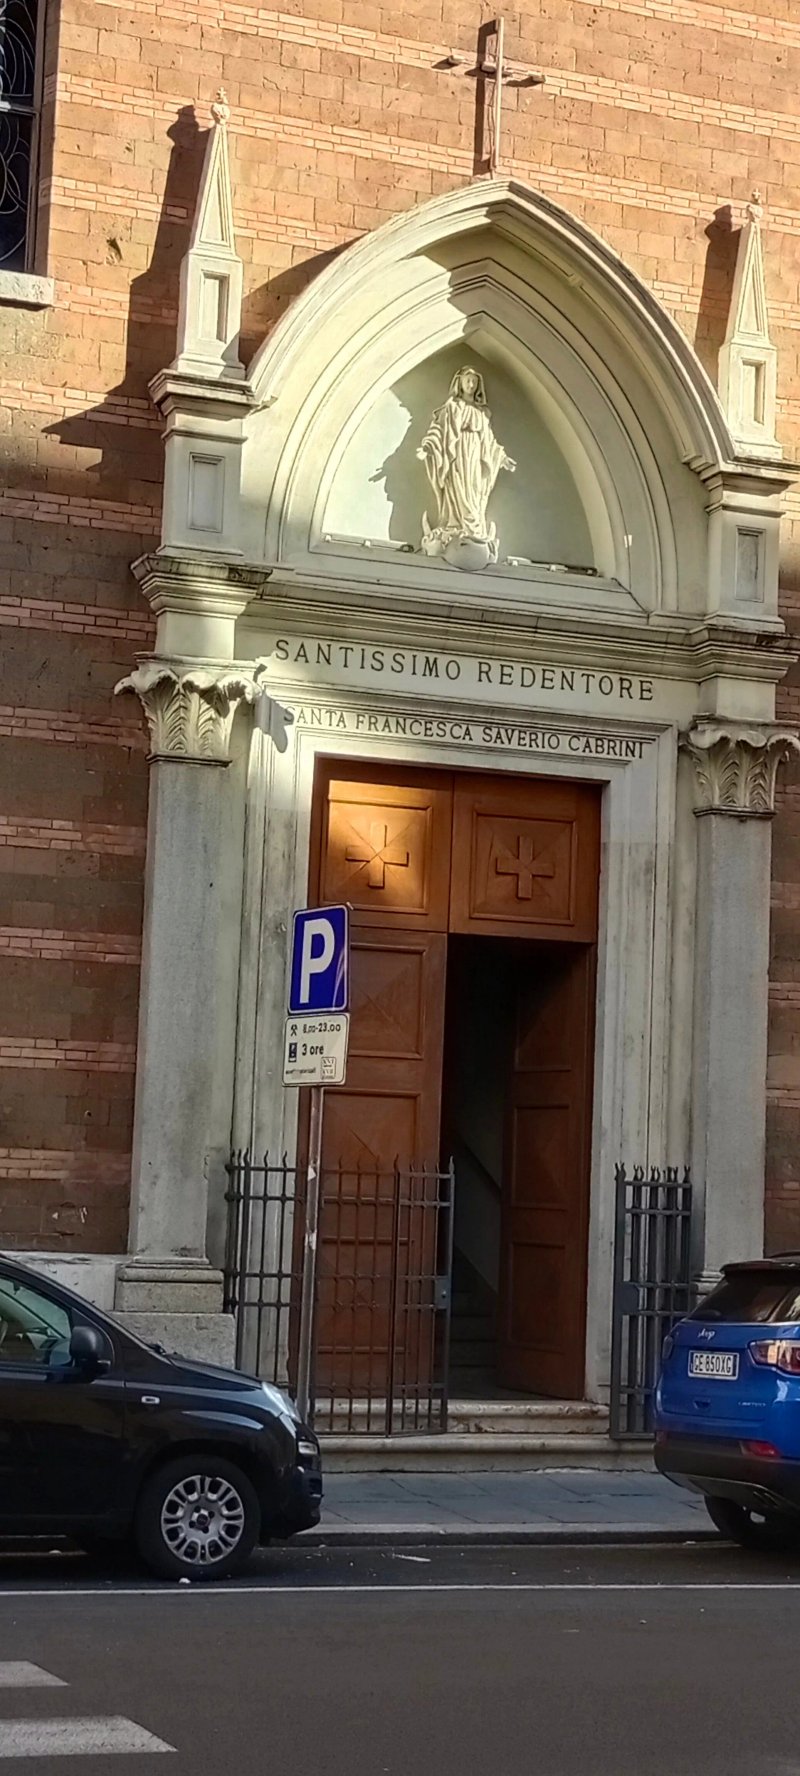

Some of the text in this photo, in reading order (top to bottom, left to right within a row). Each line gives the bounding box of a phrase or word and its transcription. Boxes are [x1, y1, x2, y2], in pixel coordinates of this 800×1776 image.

[275, 639, 654, 701] SANTISSIMO REDENTORE
[283, 706, 645, 759] SANTA FRANCESCA SAVERIO CABRINI
[300, 918, 335, 1004] P
[302, 1044, 324, 1056] 3 ore
